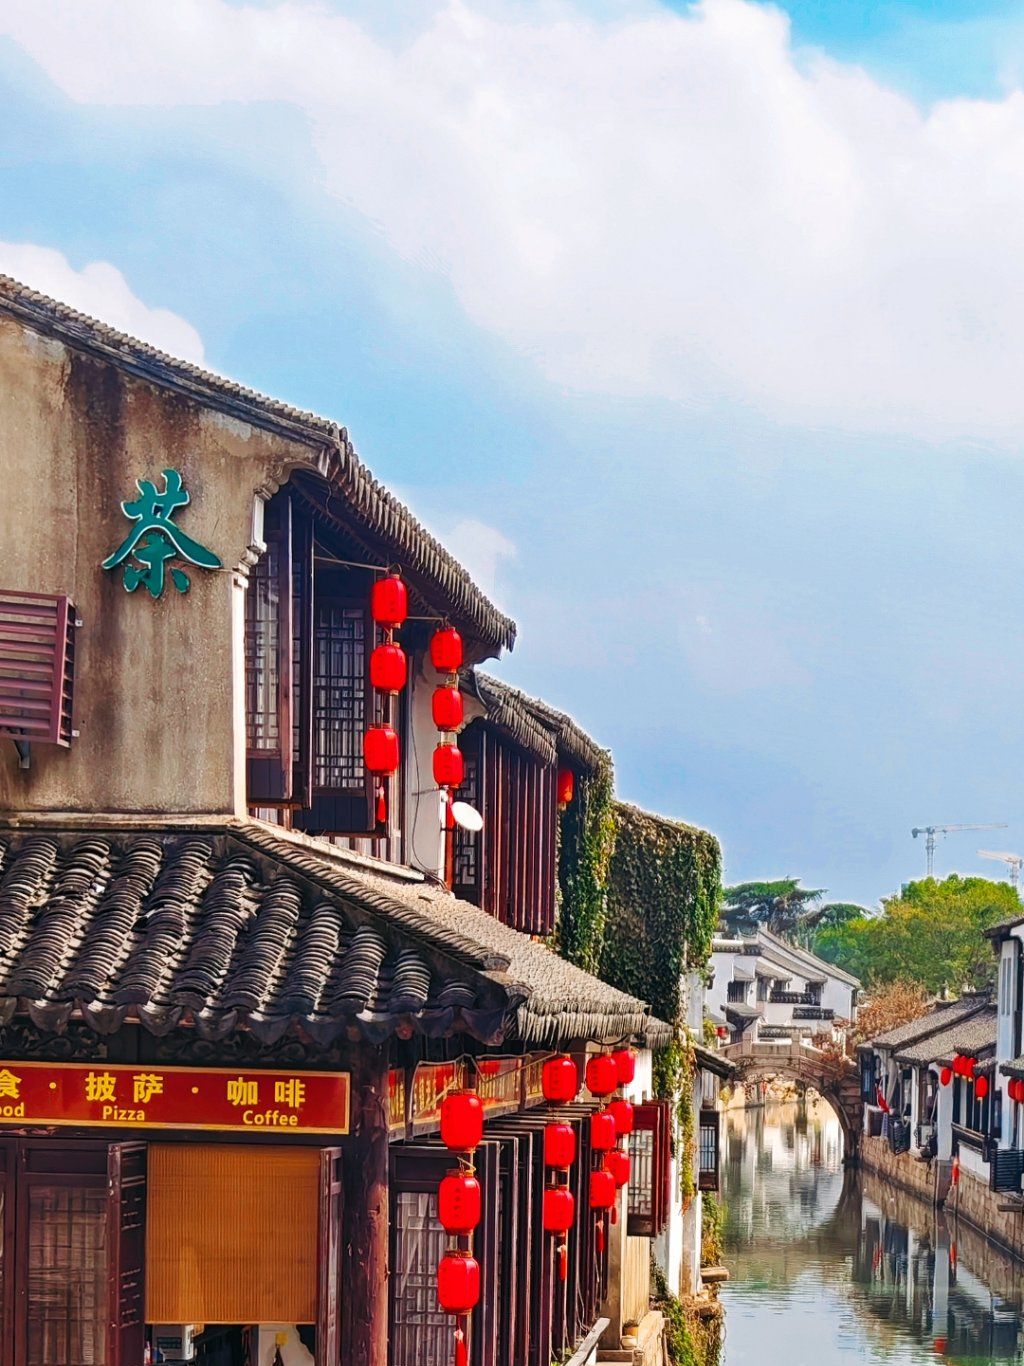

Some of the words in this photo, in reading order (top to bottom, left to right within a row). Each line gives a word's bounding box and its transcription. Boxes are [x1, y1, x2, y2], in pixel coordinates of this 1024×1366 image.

[101, 468, 224, 598] 茶
[0, 1101, 25, 1118] od
[102, 1106, 146, 1122] Pizza
[242, 1109, 299, 1126] Coffee
